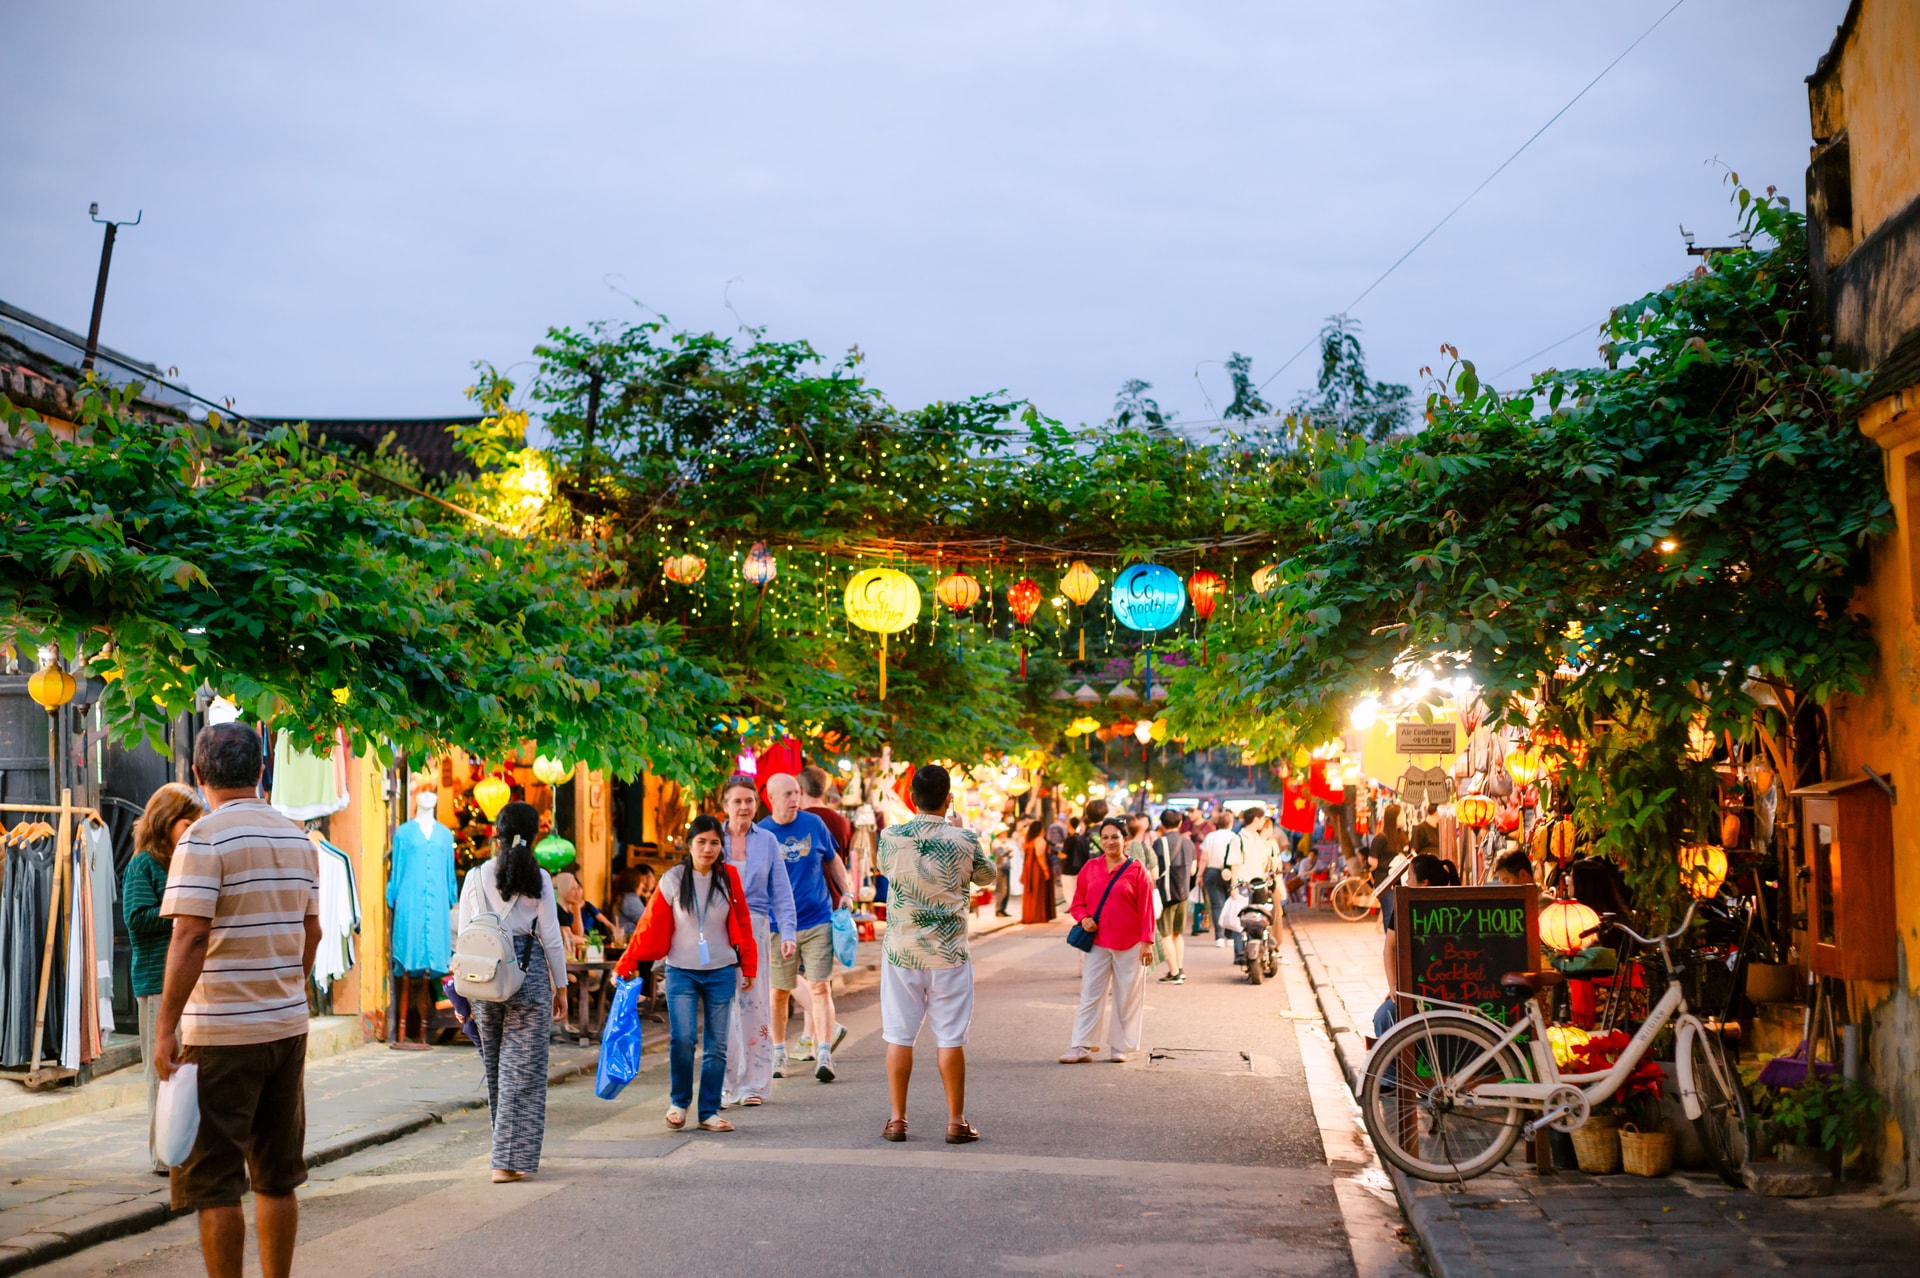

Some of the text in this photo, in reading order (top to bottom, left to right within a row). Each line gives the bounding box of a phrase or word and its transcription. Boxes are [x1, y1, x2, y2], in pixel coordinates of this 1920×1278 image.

[1413, 728, 1450, 736] Conditioner
[1412, 907, 1525, 934] HAPPY HOUR
[1444, 941, 1485, 960] Beer
[1416, 983, 1457, 1000] Mix
